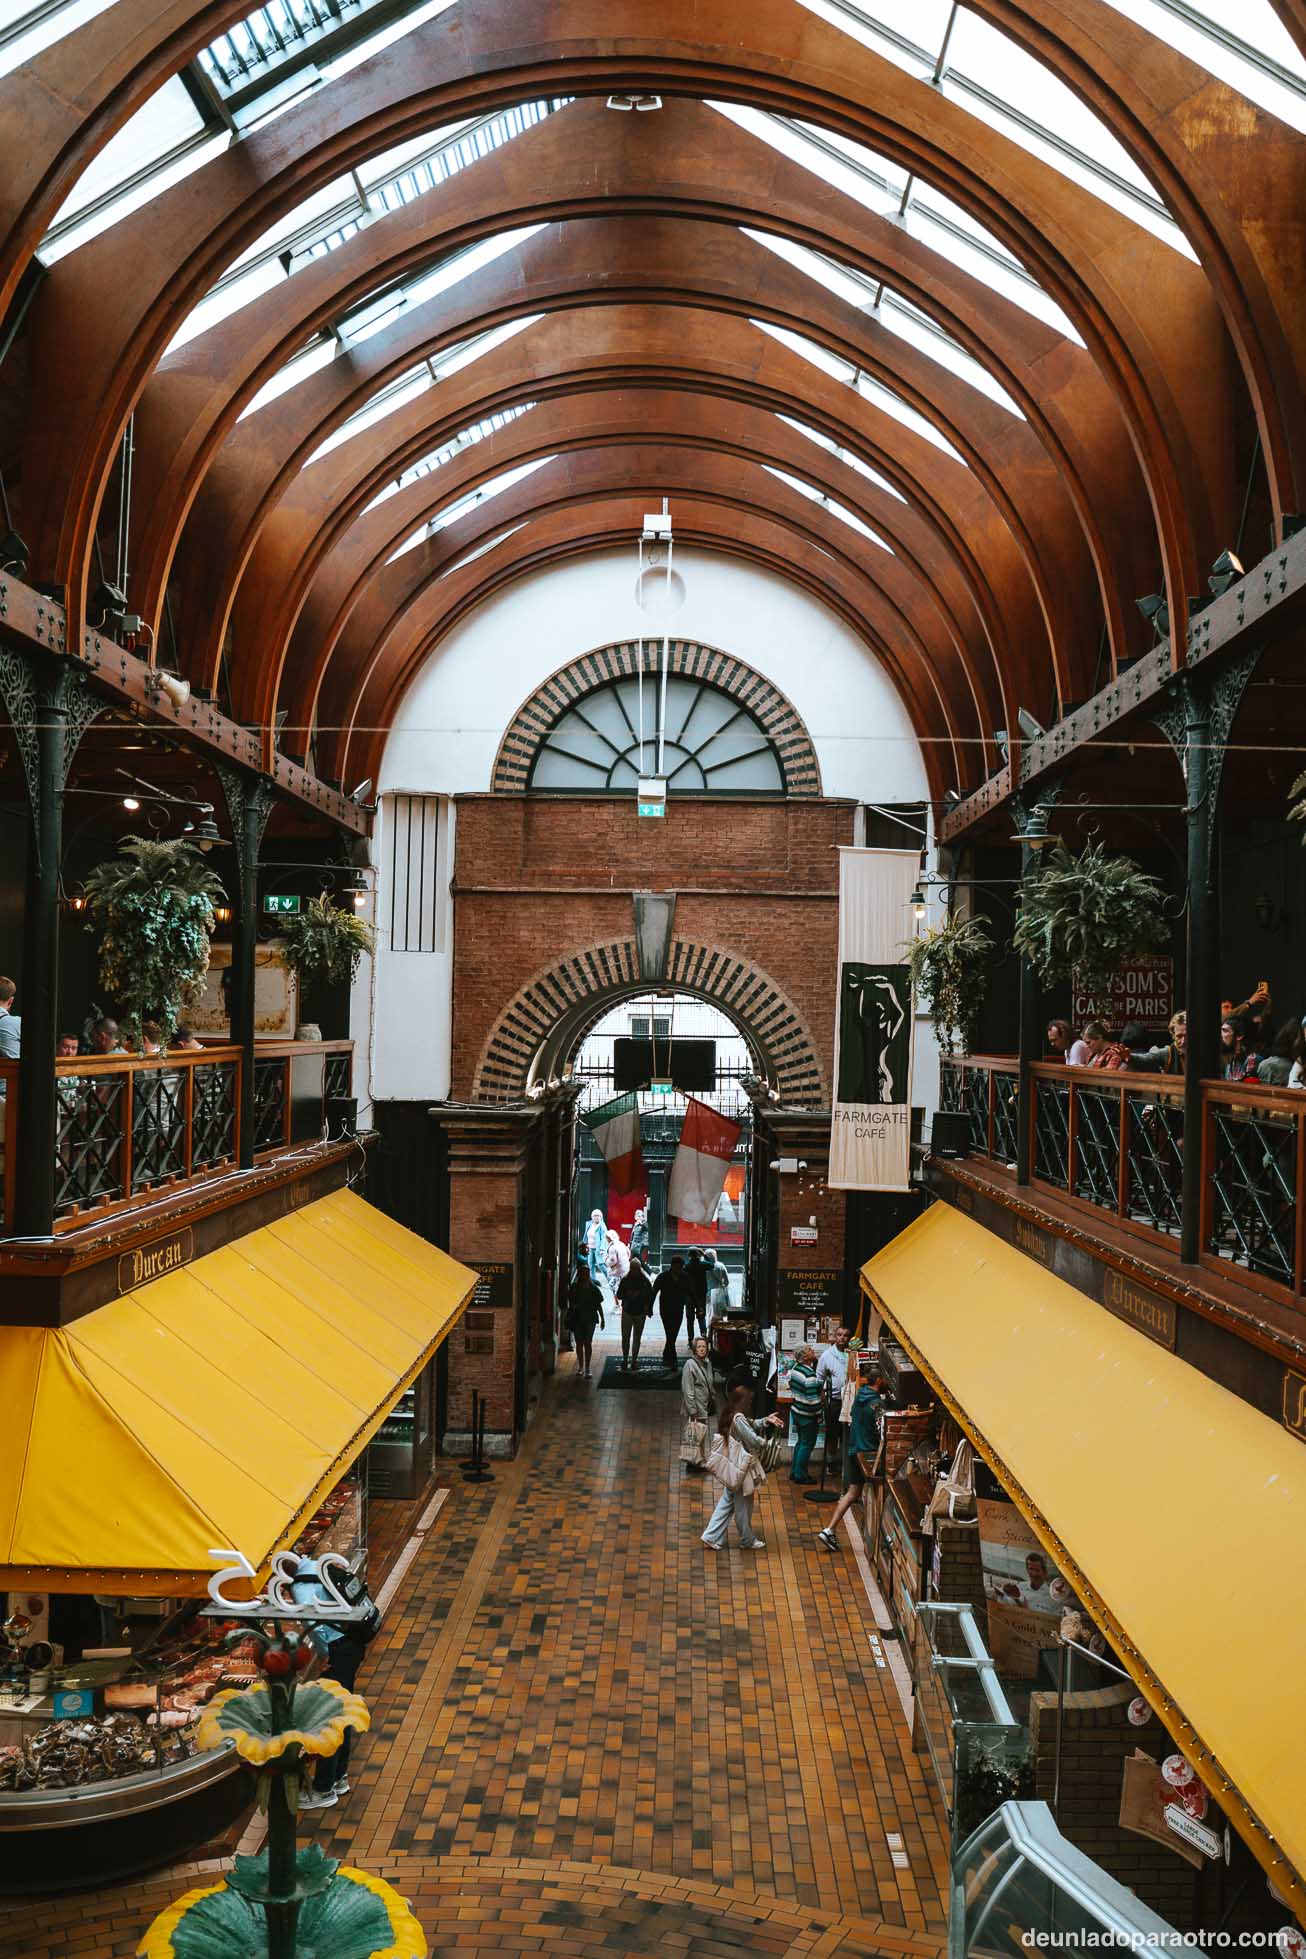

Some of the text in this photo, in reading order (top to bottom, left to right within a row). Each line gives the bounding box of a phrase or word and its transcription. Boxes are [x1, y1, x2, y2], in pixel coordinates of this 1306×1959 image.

[1126, 998, 1168, 1015] PARIS
[834, 1110, 908, 1124] FARMGATE
[854, 1127, 886, 1139] CAFÉ
[136, 1248, 180, 1278] Durcan
[786, 1272, 836, 1280] FARMGATE
[1111, 1274, 1168, 1334] Durcan
